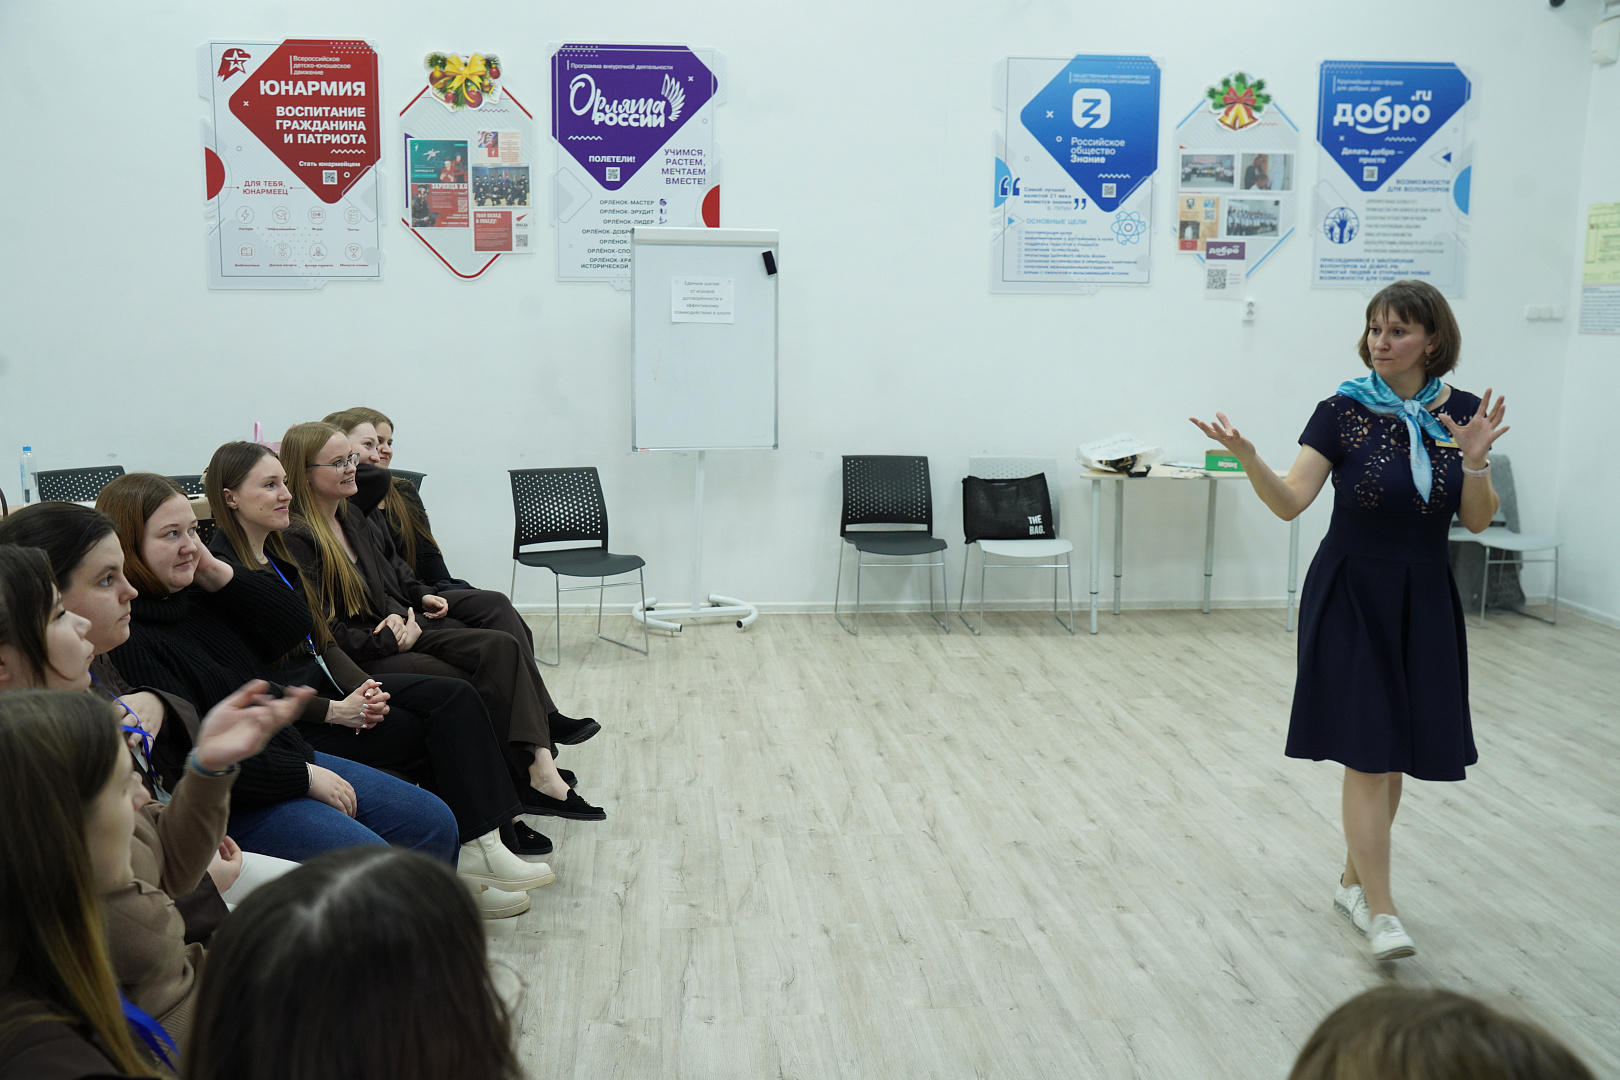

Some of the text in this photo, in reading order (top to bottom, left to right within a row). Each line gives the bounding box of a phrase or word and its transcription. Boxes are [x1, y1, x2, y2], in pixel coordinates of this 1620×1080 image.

[570, 62, 602, 70] Программа
[603, 63, 635, 71] внеурочной
[259, 80, 366, 96] ЮНАРМИЯ
[570, 73, 666, 121] Орлята
[276, 106, 366, 117] ВОСПИТАНИЕ
[1333, 96, 1430, 130] добро
[594, 112, 666, 128] РОССИИ
[275, 120, 367, 132] ГРАЖДАНИНА
[283, 134, 367, 144] И ПАТРИОТА
[1071, 137, 1126, 147] Российское
[664, 149, 706, 158] УЧИМСЯ,
[1071, 146, 1116, 156] общество
[1341, 147, 1369, 156] Делать
[1370, 148, 1395, 156] добро
[665, 158, 706, 167] РАСТЕМ,
[1071, 155, 1106, 163] Знание
[661, 168, 706, 176] МЕЧТАЕМ
[244, 180, 287, 189] ДЛЯ ТЕБЯ,
[665, 177, 706, 185] ВМЕСТЕ!
[242, 188, 289, 197] ЮНАРМЕЕЦ
[1208, 246, 1239, 256] добро
[1027, 514, 1043, 525] THE
